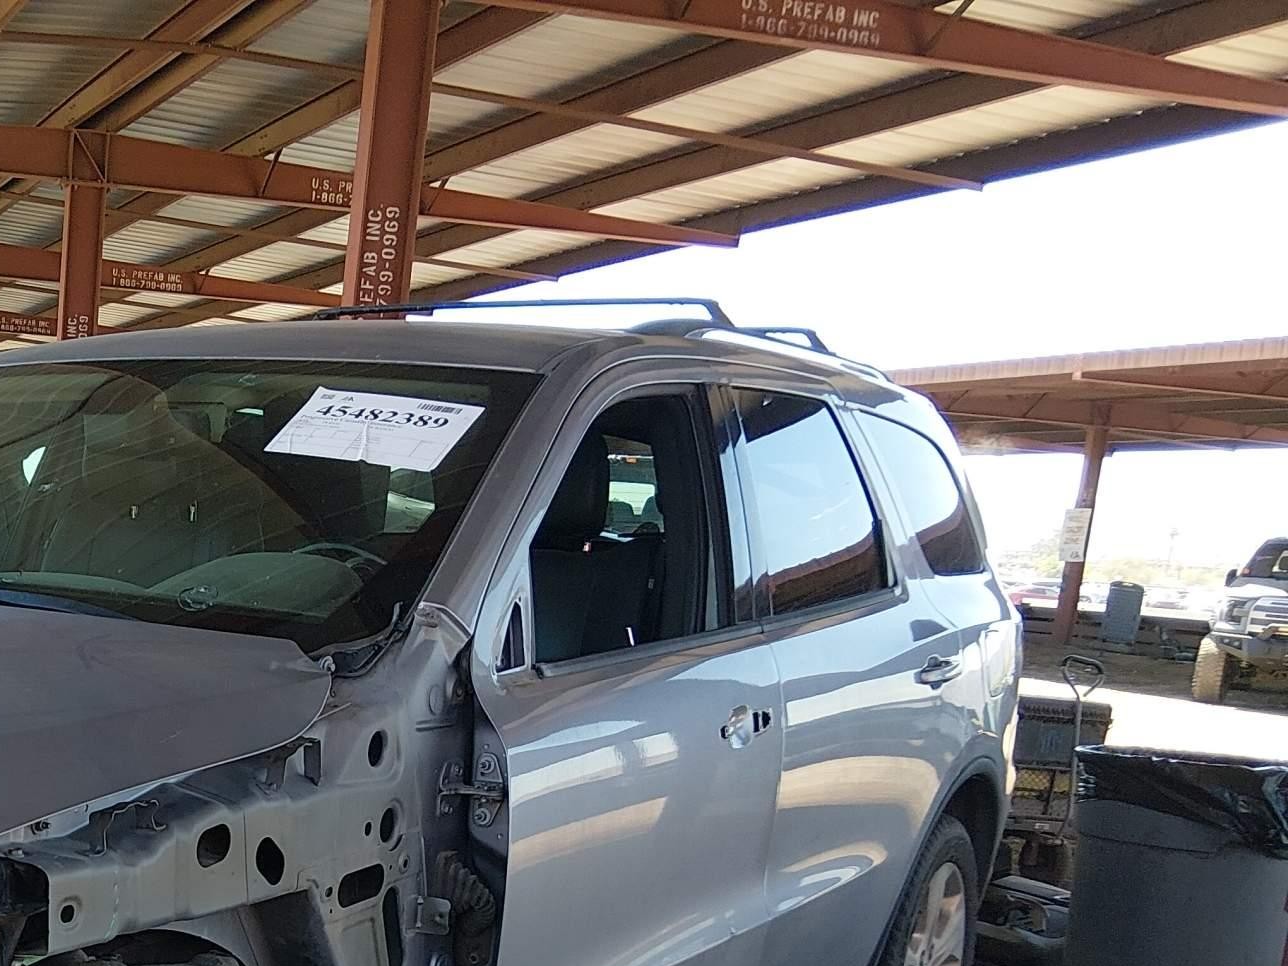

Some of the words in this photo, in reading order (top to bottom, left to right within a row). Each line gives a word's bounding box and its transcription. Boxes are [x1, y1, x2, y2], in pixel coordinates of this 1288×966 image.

[782, 0, 846, 24] PREFAB
[312, 177, 332, 192] U.S.
[366, 204, 384, 241] INC.
[132, 270, 164, 282] PREFAB
[316, 404, 449, 430] 45482389
